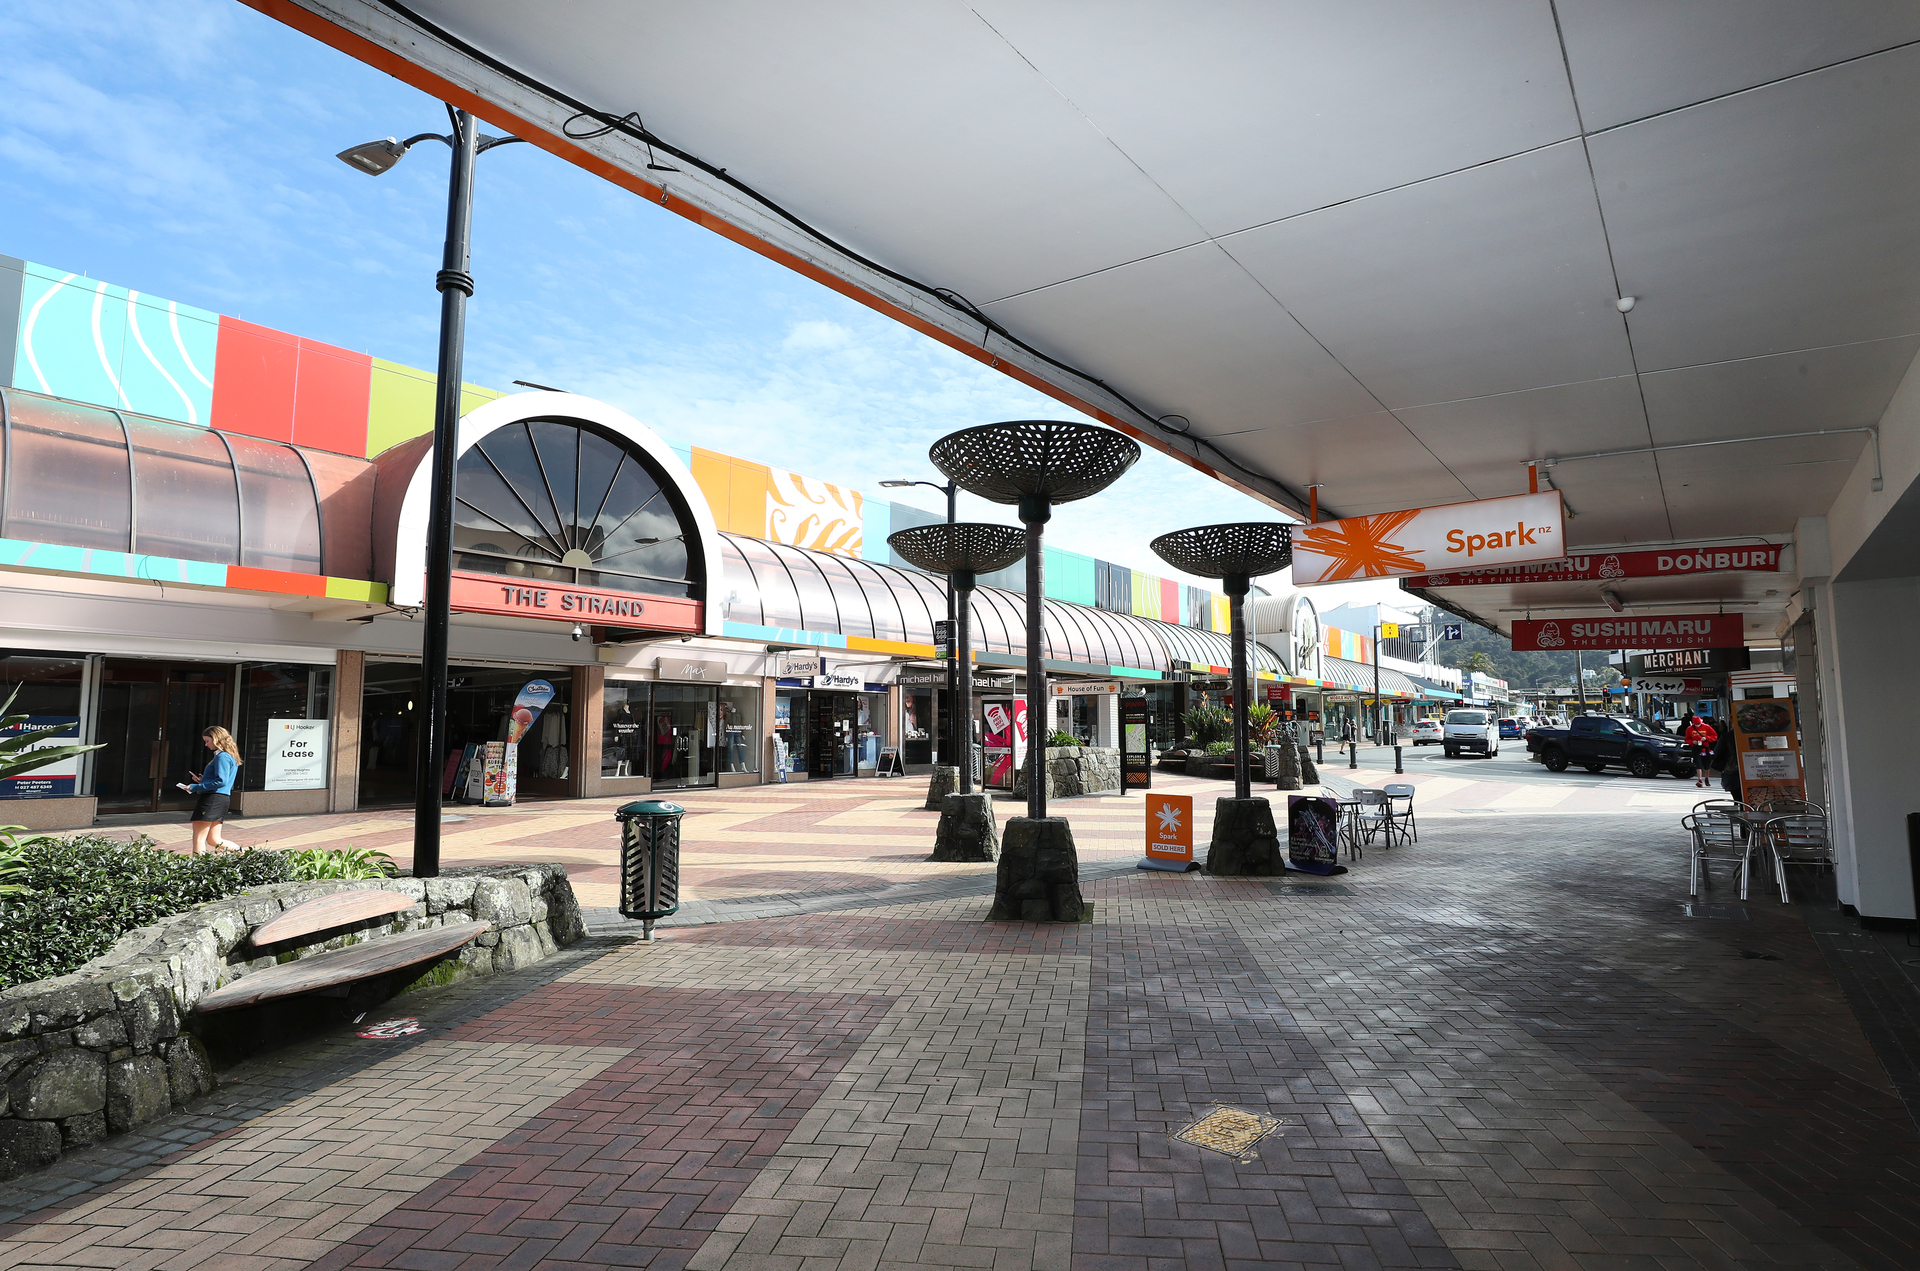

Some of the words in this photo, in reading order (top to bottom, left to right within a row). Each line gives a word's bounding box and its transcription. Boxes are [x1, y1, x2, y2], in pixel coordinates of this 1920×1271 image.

[1446, 522, 1537, 557] Spark
[1538, 526, 1552, 534] nz
[503, 586, 549, 607] THE
[563, 593, 645, 617] STRAND
[1605, 637, 1658, 645] FINEST
[1666, 636, 1712, 644] SUSHI
[1644, 649, 1711, 668] MERCHANT
[680, 663, 707, 679] Max
[794, 661, 818, 671] Hardy's
[834, 675, 859, 686] Hardy's
[900, 674, 932, 684] michael
[933, 673, 945, 682] hill
[990, 677, 1002, 688] hill
[290, 740, 308, 748] For
[282, 750, 314, 758] Lease
[1159, 832, 1178, 840] Spark
